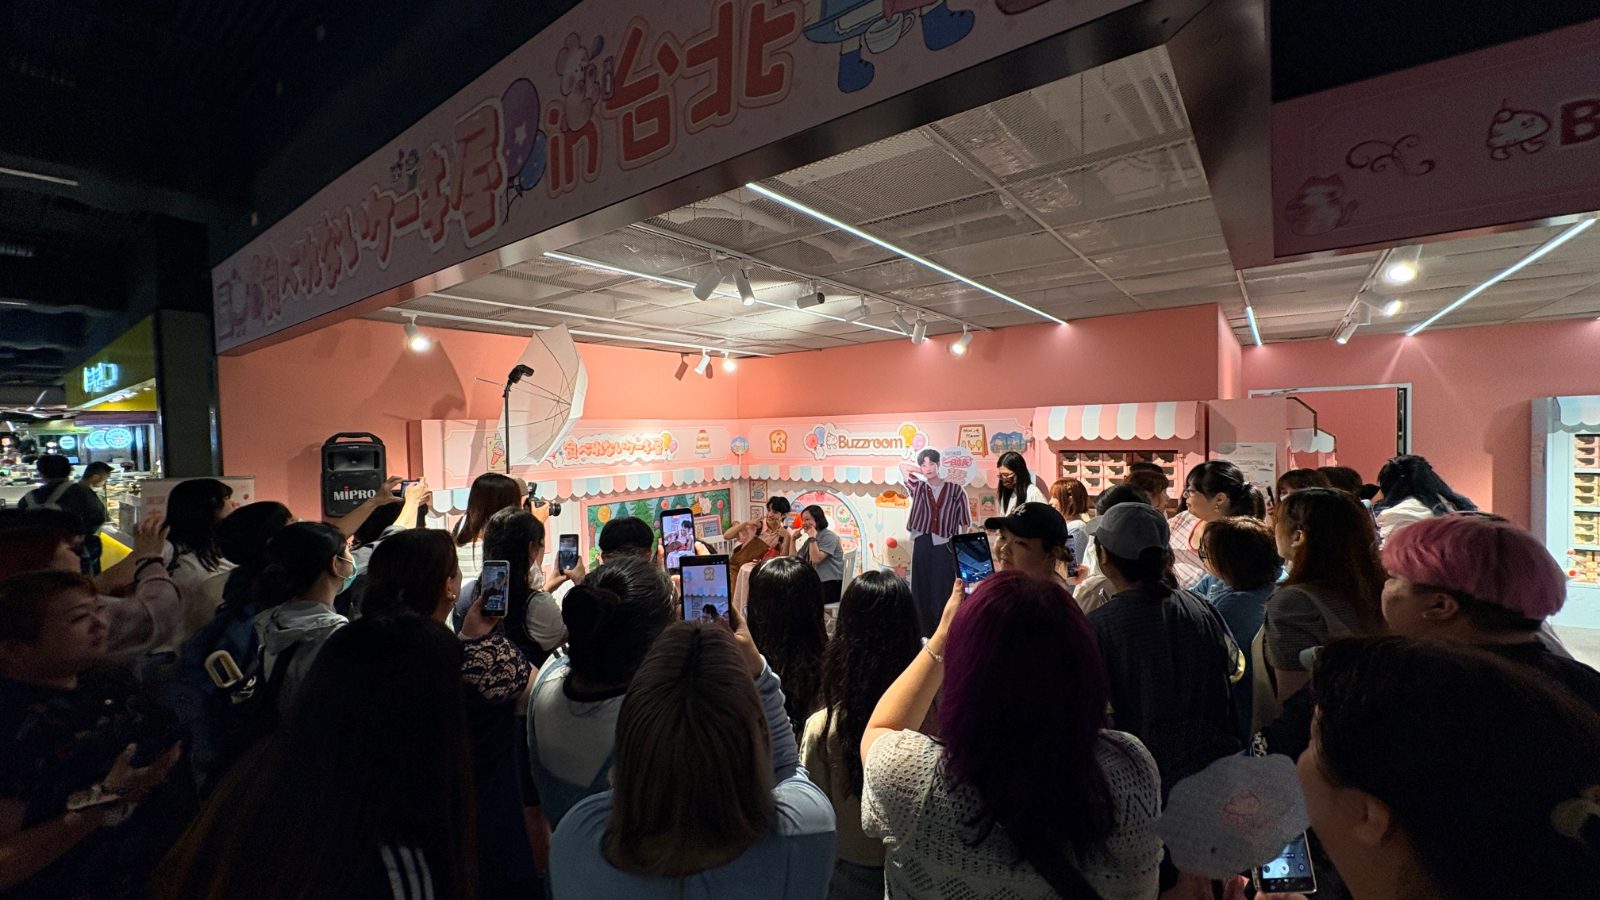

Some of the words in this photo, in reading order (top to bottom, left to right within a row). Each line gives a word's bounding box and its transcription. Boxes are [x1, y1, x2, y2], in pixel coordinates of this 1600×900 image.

[548, 107, 600, 193] in
[604, 1, 798, 163] 台北
[838, 434, 904, 449] Buzzroom
